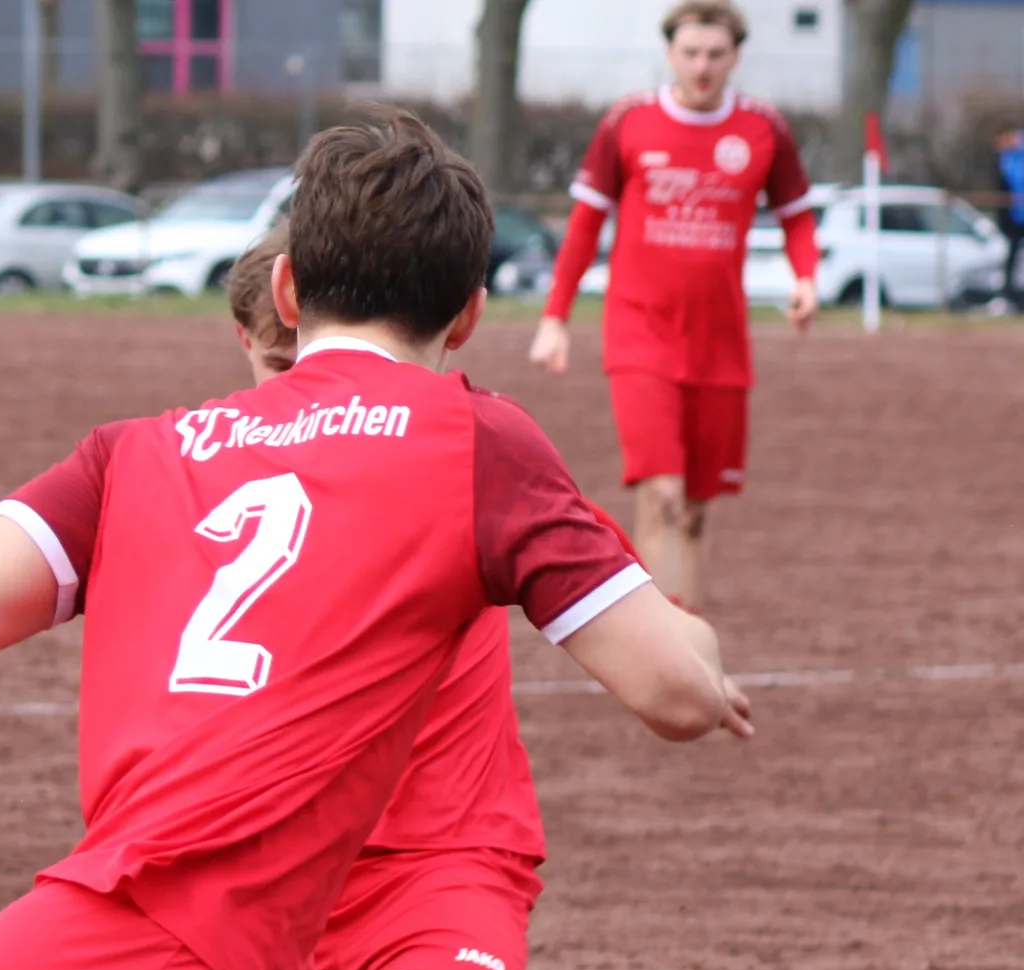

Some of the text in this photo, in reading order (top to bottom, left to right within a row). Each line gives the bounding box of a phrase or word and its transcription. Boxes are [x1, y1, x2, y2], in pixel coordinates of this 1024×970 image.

[175, 395, 411, 461] SC Neukirchen
[168, 471, 313, 696] 2
